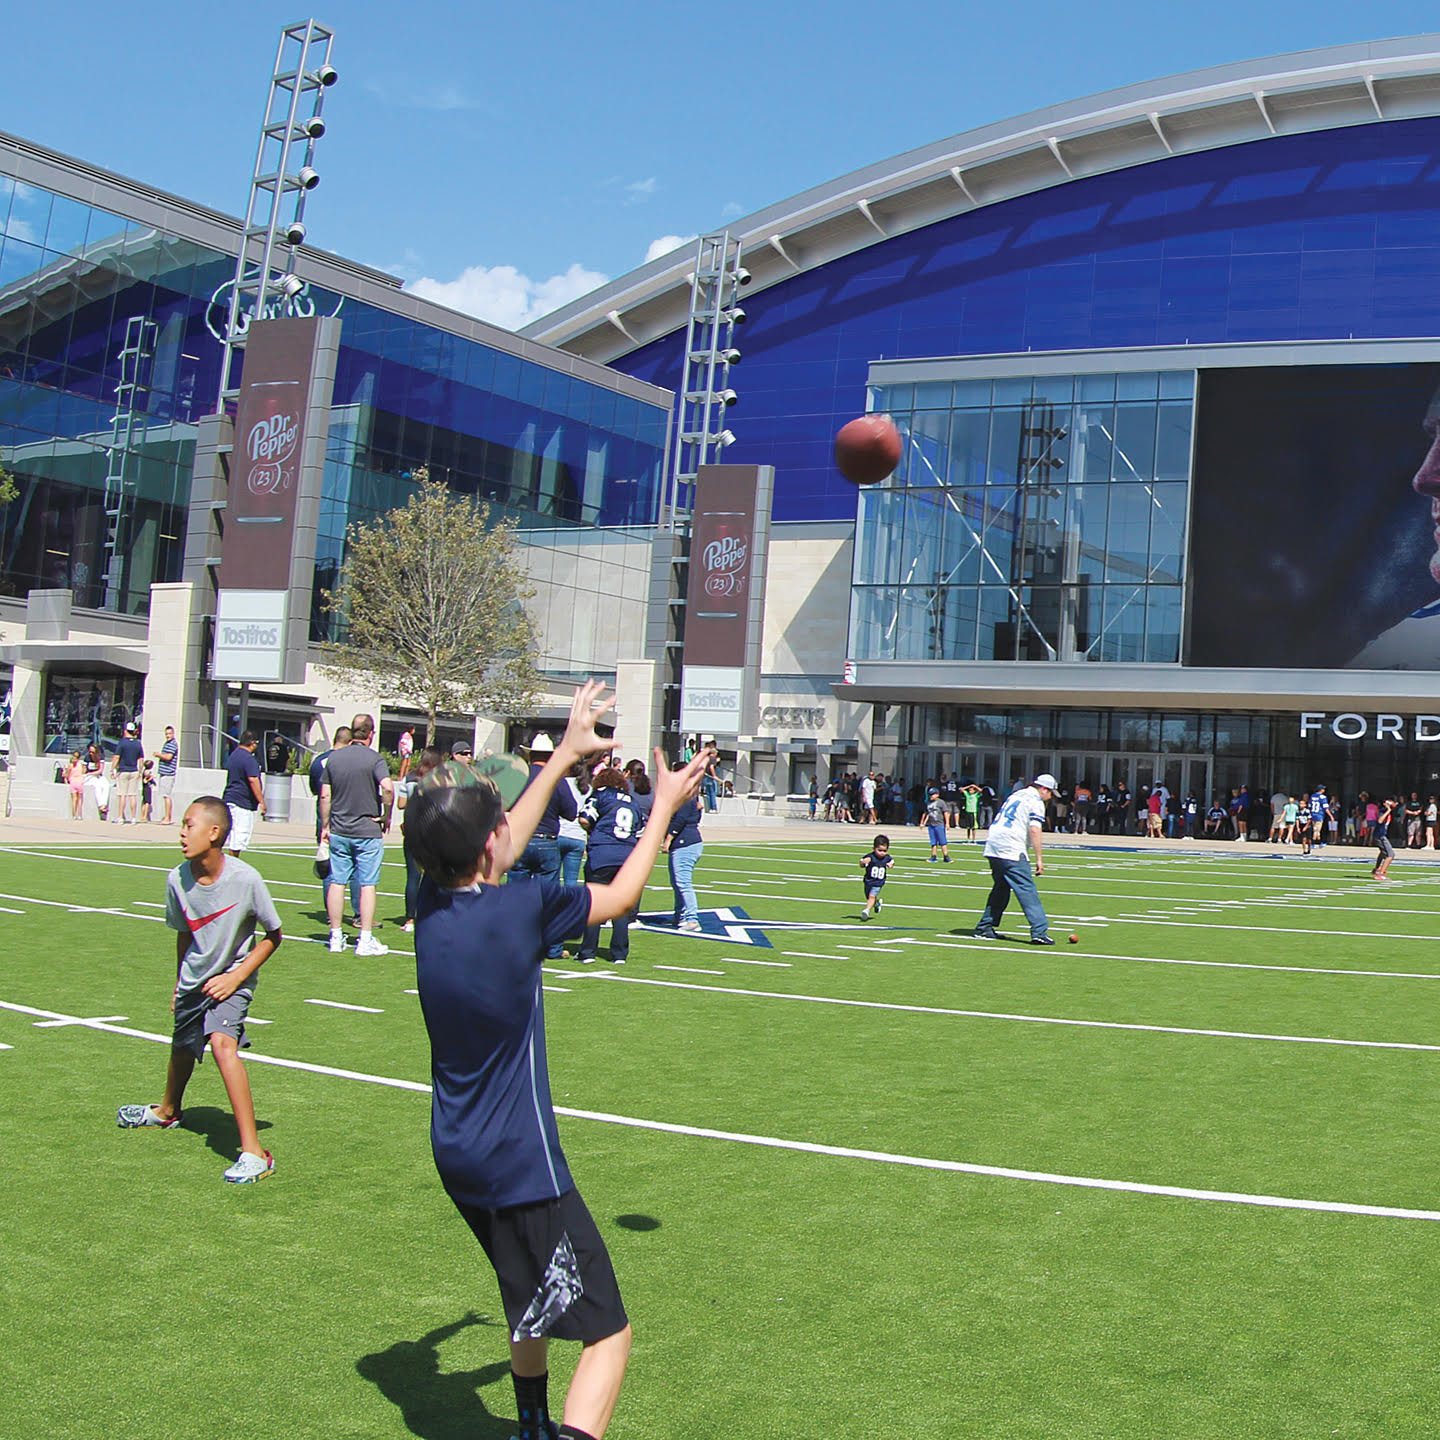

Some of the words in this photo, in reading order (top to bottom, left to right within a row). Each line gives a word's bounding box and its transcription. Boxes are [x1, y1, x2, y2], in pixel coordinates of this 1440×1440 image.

[270, 414, 291, 438] Dr
[247, 420, 298, 461] Pepper
[257, 470, 271, 487] 23
[722, 536, 741, 554] Dr
[703, 541, 747, 571] Pepper
[713, 578, 725, 591] 23
[760, 706, 826, 727] CKETS
[613, 807, 634, 839] 9
[870, 866, 885, 880] 88
